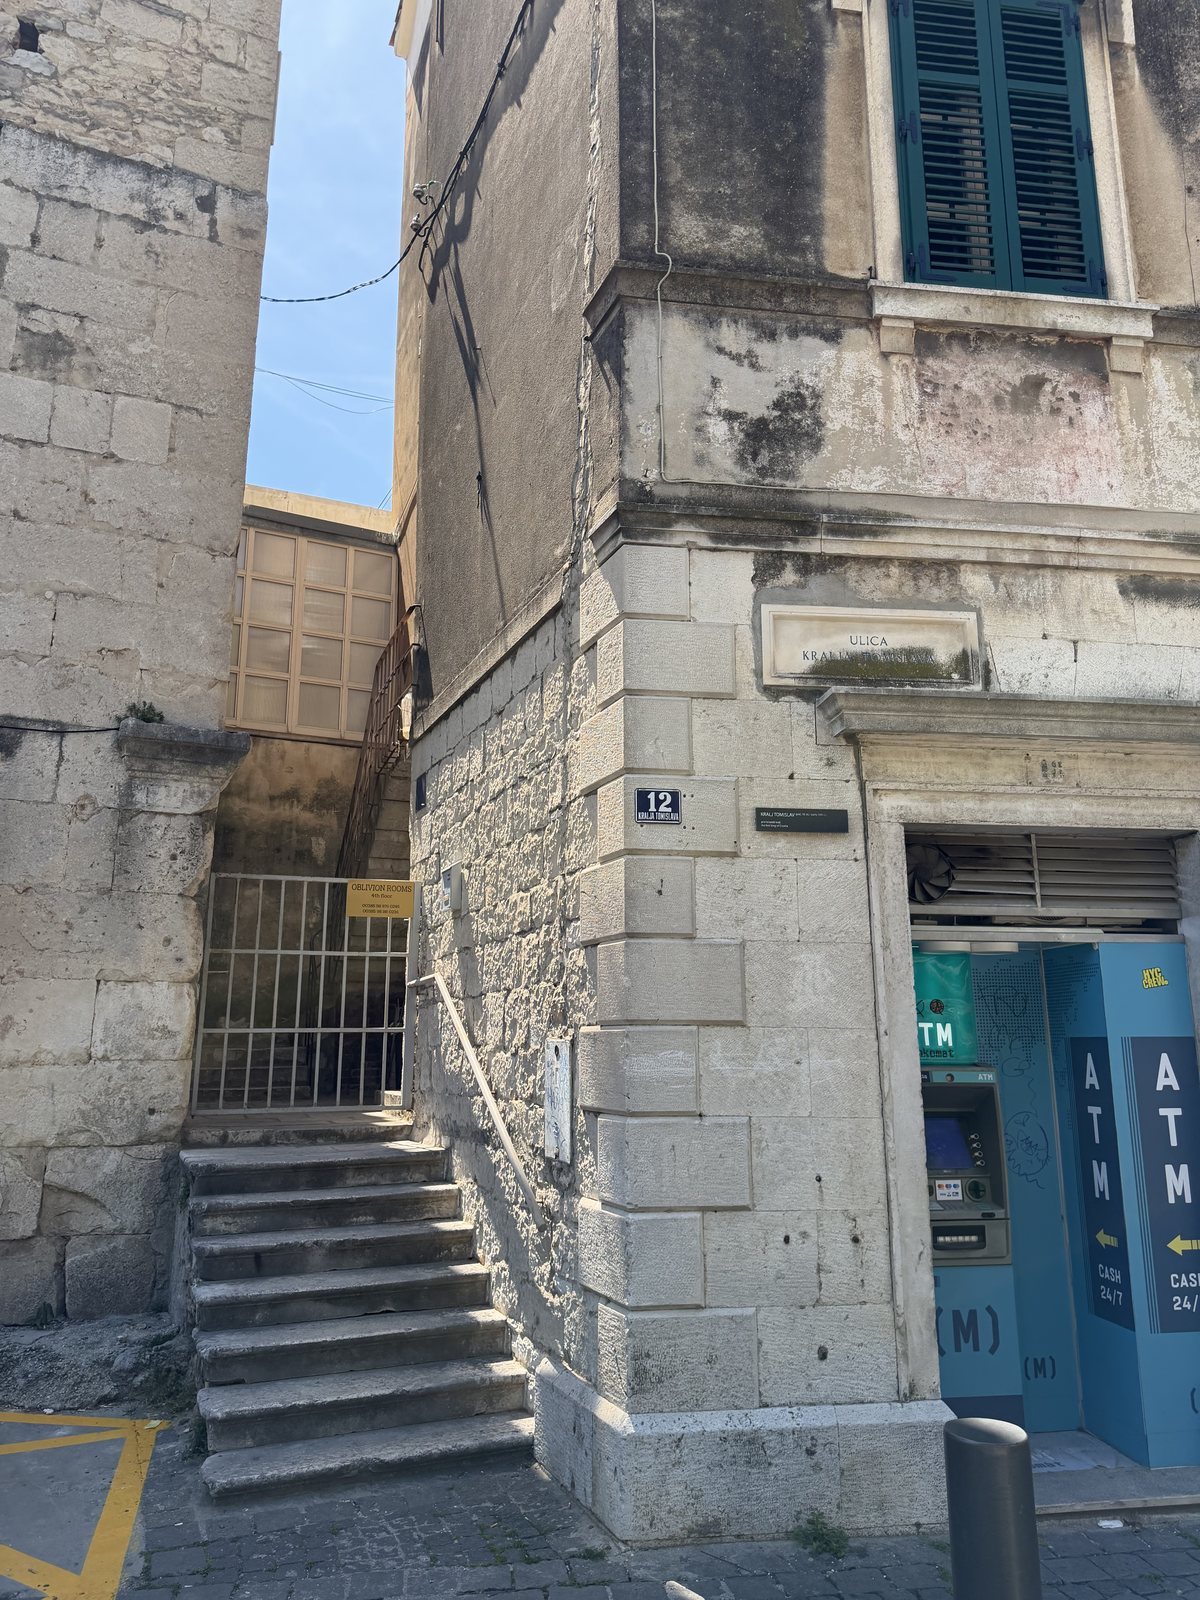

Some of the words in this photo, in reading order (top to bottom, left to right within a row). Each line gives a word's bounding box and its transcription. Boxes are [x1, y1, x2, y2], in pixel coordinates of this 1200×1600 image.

[849, 635, 888, 647] ULICA
[647, 791, 672, 812] 12
[638, 811, 655, 820] KRALJA
[655, 812, 679, 821] TOMISLAVA
[351, 883, 385, 892] OBLIVION
[386, 884, 412, 893] ROOMS
[918, 1022, 953, 1047] TM
[978, 1073, 993, 1081] ATM
[1084, 1052, 1109, 1201] ATM
[1155, 1052, 1192, 1204] ATM
[1098, 1263, 1122, 1284] CASH
[1170, 1272, 1200, 1288] CAS
[1100, 1285, 1123, 1306] 24/7
[1172, 1294, 1200, 1313] 24/
